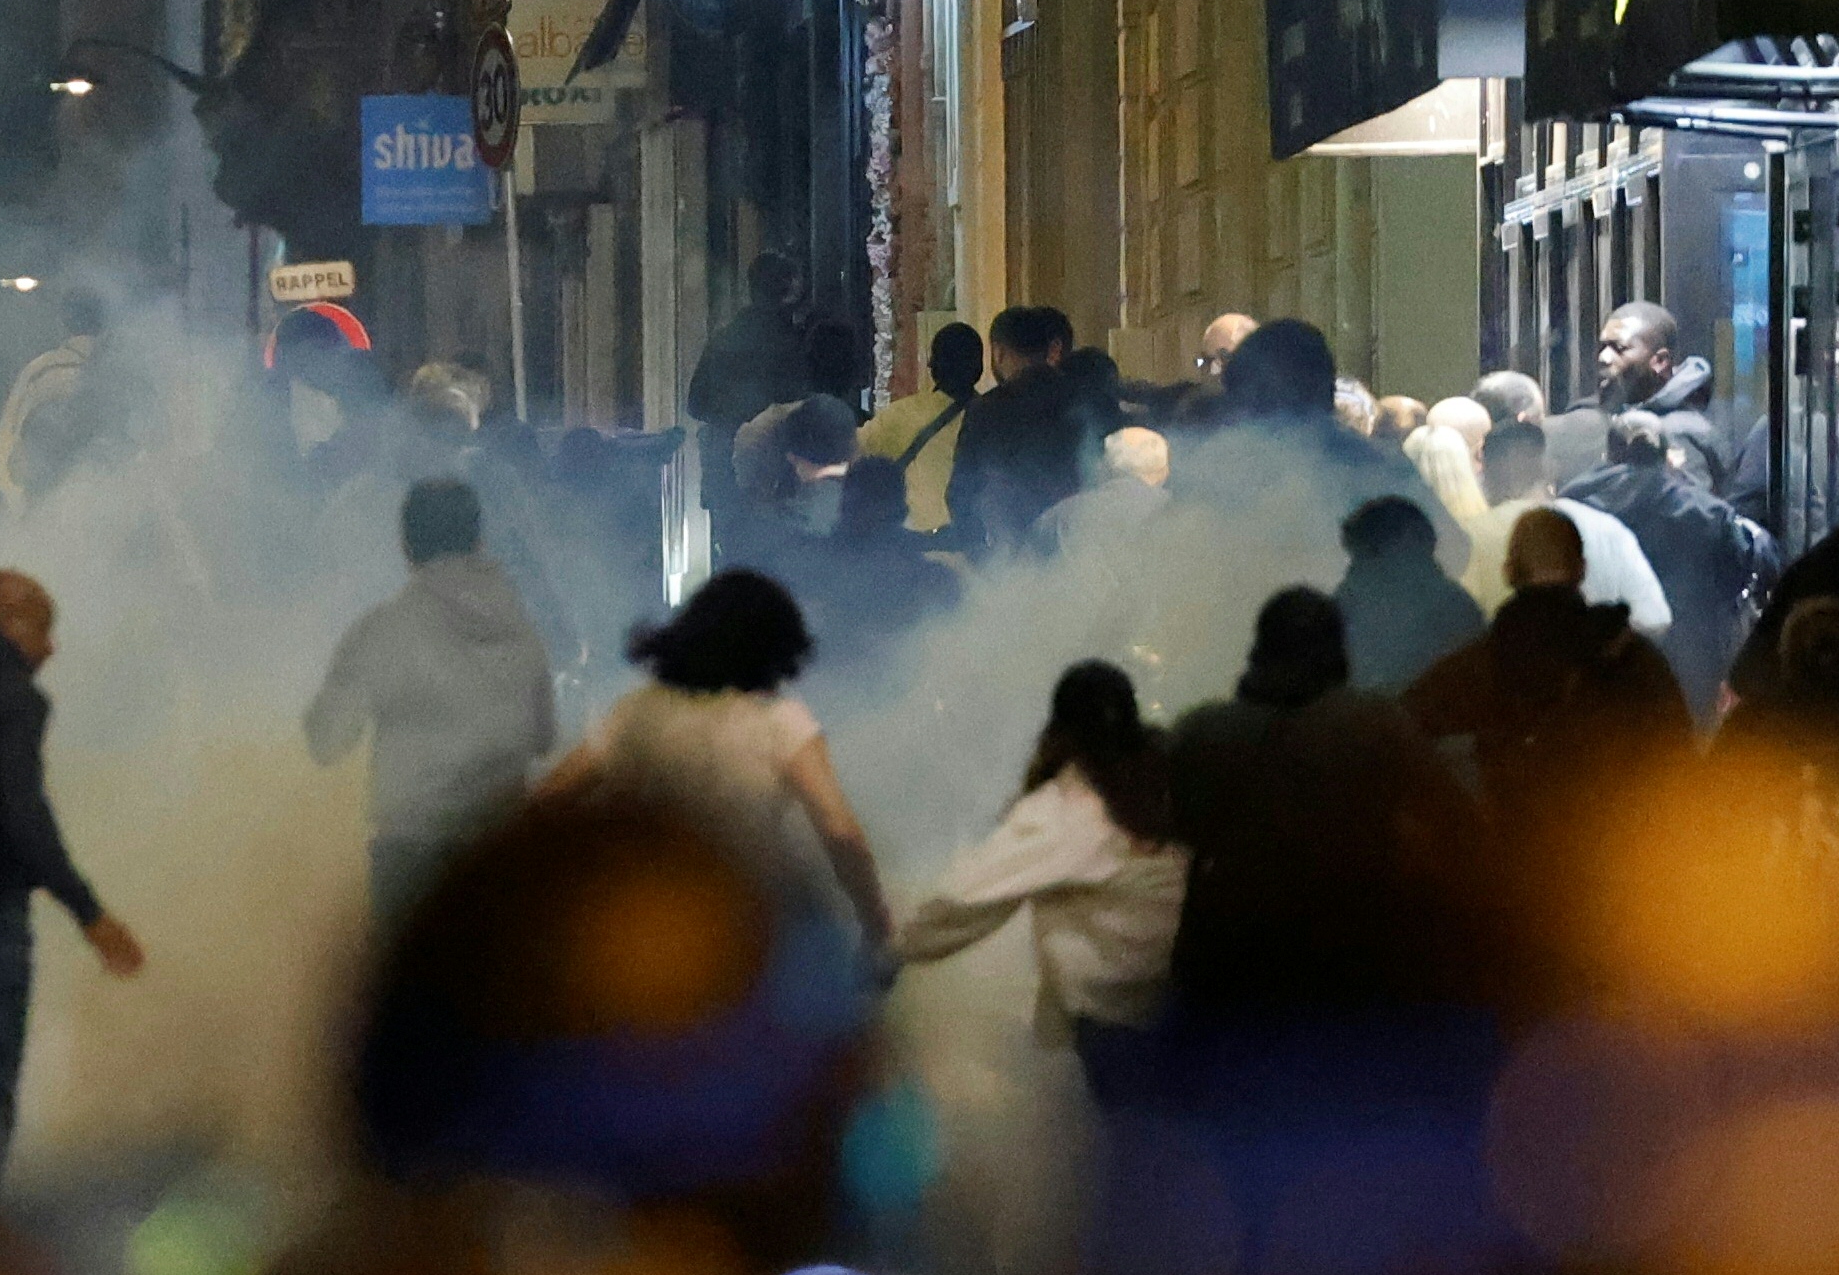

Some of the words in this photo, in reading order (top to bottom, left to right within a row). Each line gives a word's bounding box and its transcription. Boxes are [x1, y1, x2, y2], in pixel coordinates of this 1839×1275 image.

[479, 65, 509, 132] 30
[373, 122, 476, 170] shiva
[275, 271, 349, 292] RAPPEL
